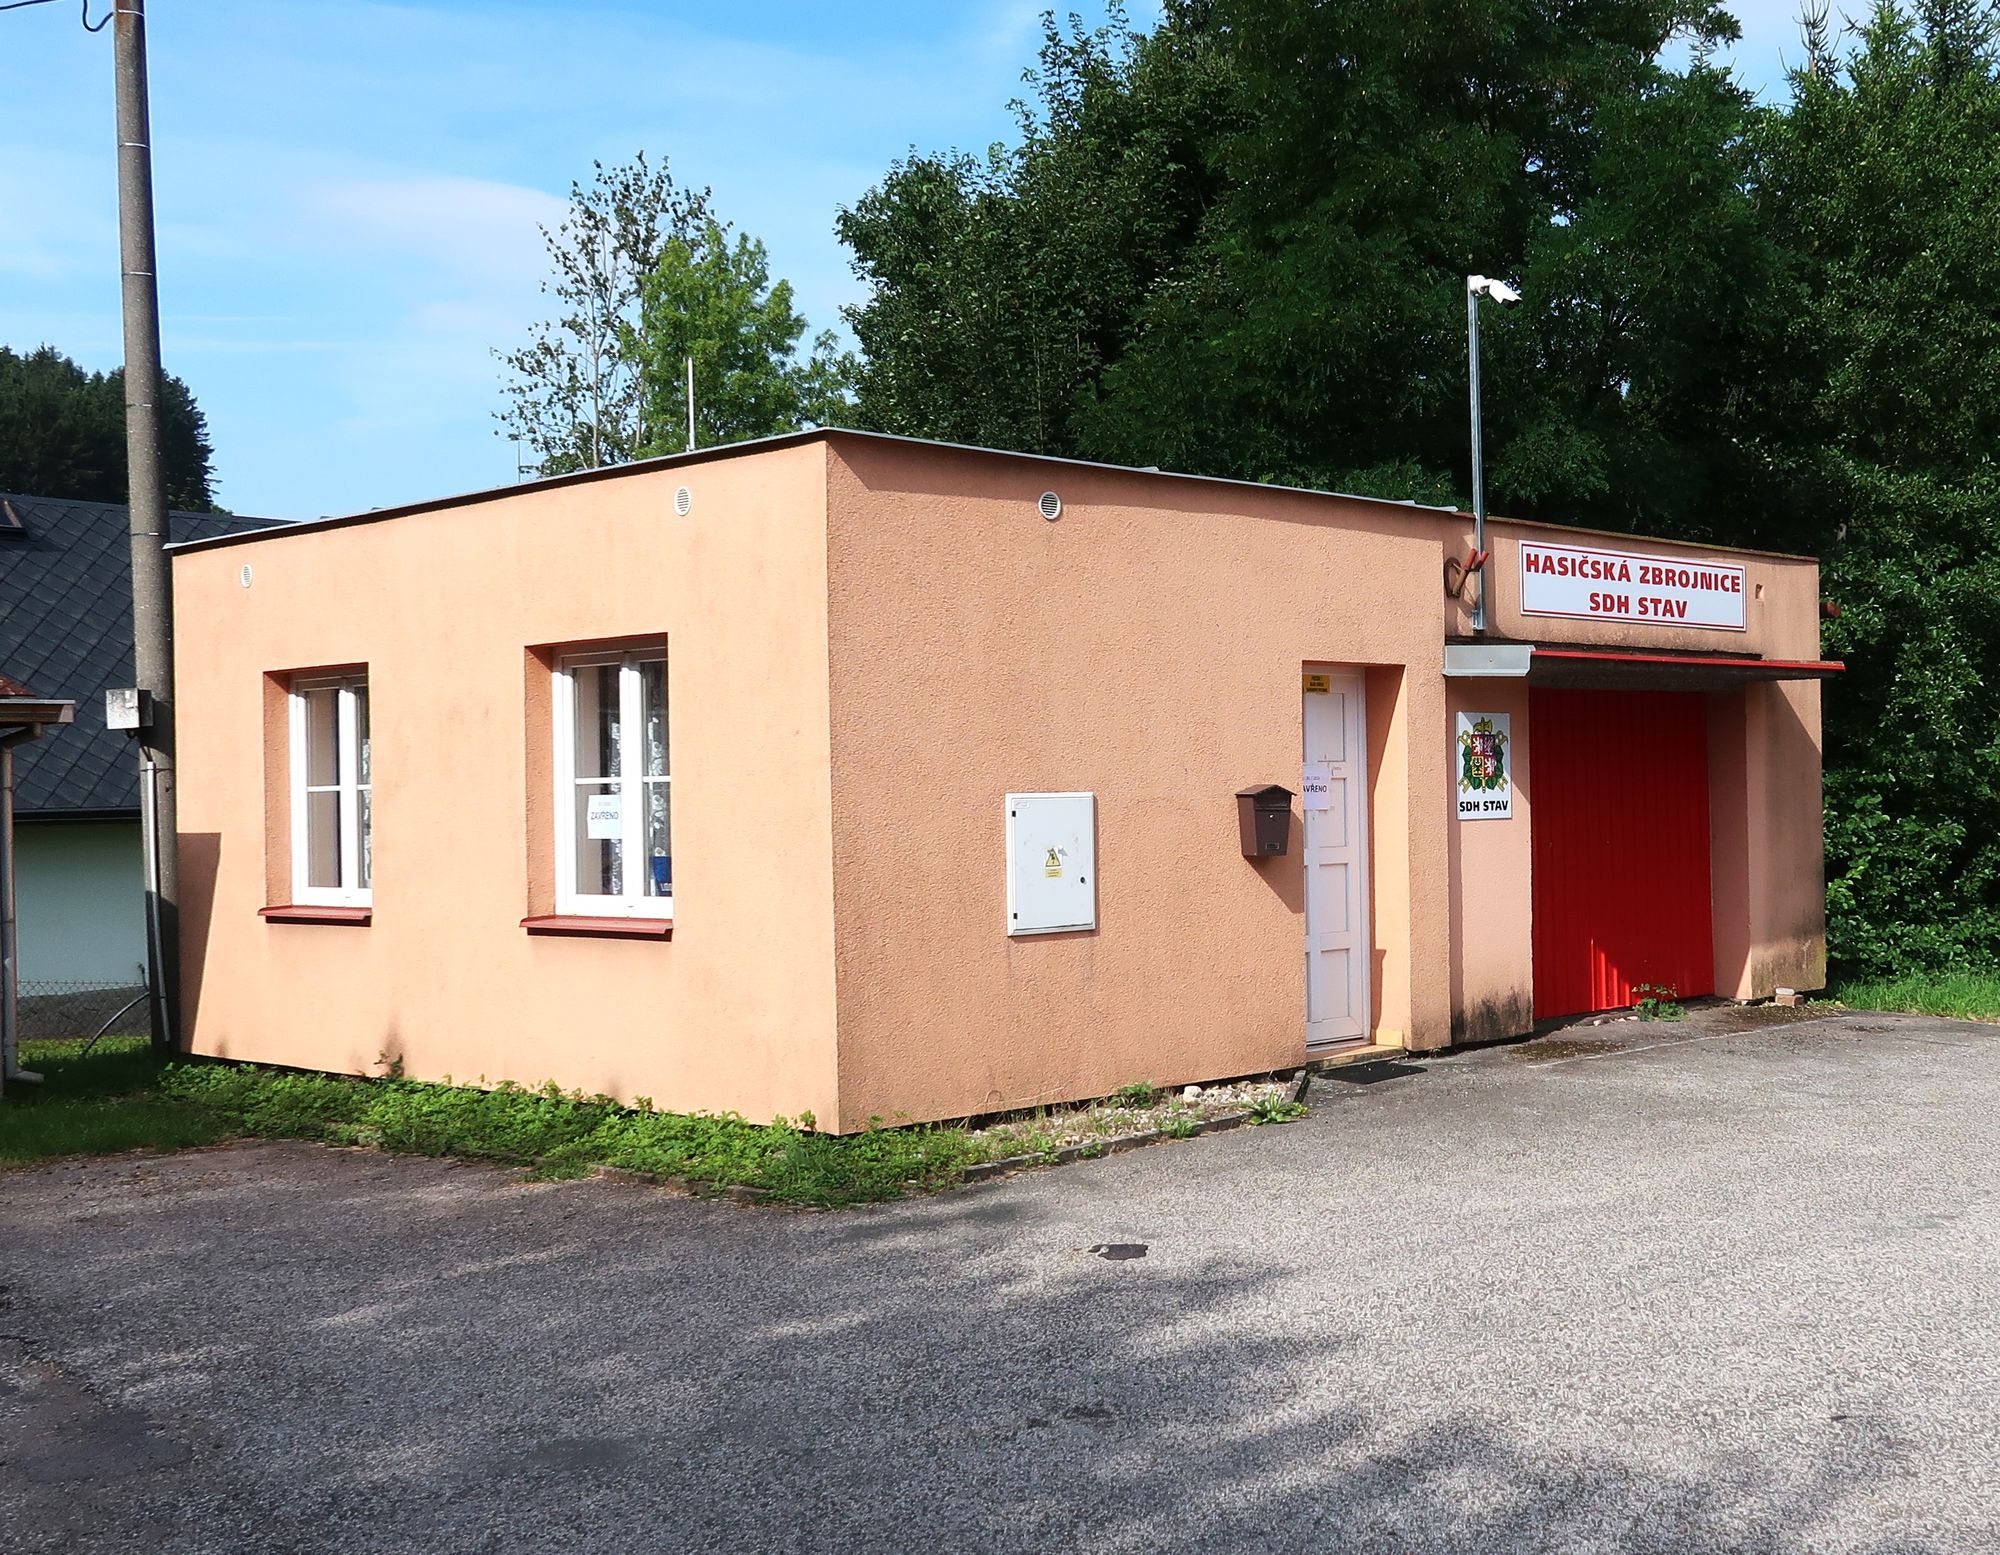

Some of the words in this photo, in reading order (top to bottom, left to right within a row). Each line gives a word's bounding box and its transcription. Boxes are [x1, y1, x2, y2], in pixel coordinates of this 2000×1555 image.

[1525, 553, 1632, 583] HASIČSKÁ
[1639, 565, 1741, 593] ZBROJNICE
[1589, 592, 1630, 614] SDH
[1637, 596, 1688, 618] STAV
[1302, 783, 1328, 793] AVŘENO
[1459, 801, 1480, 812] SDH
[1483, 800, 1509, 812] STAV
